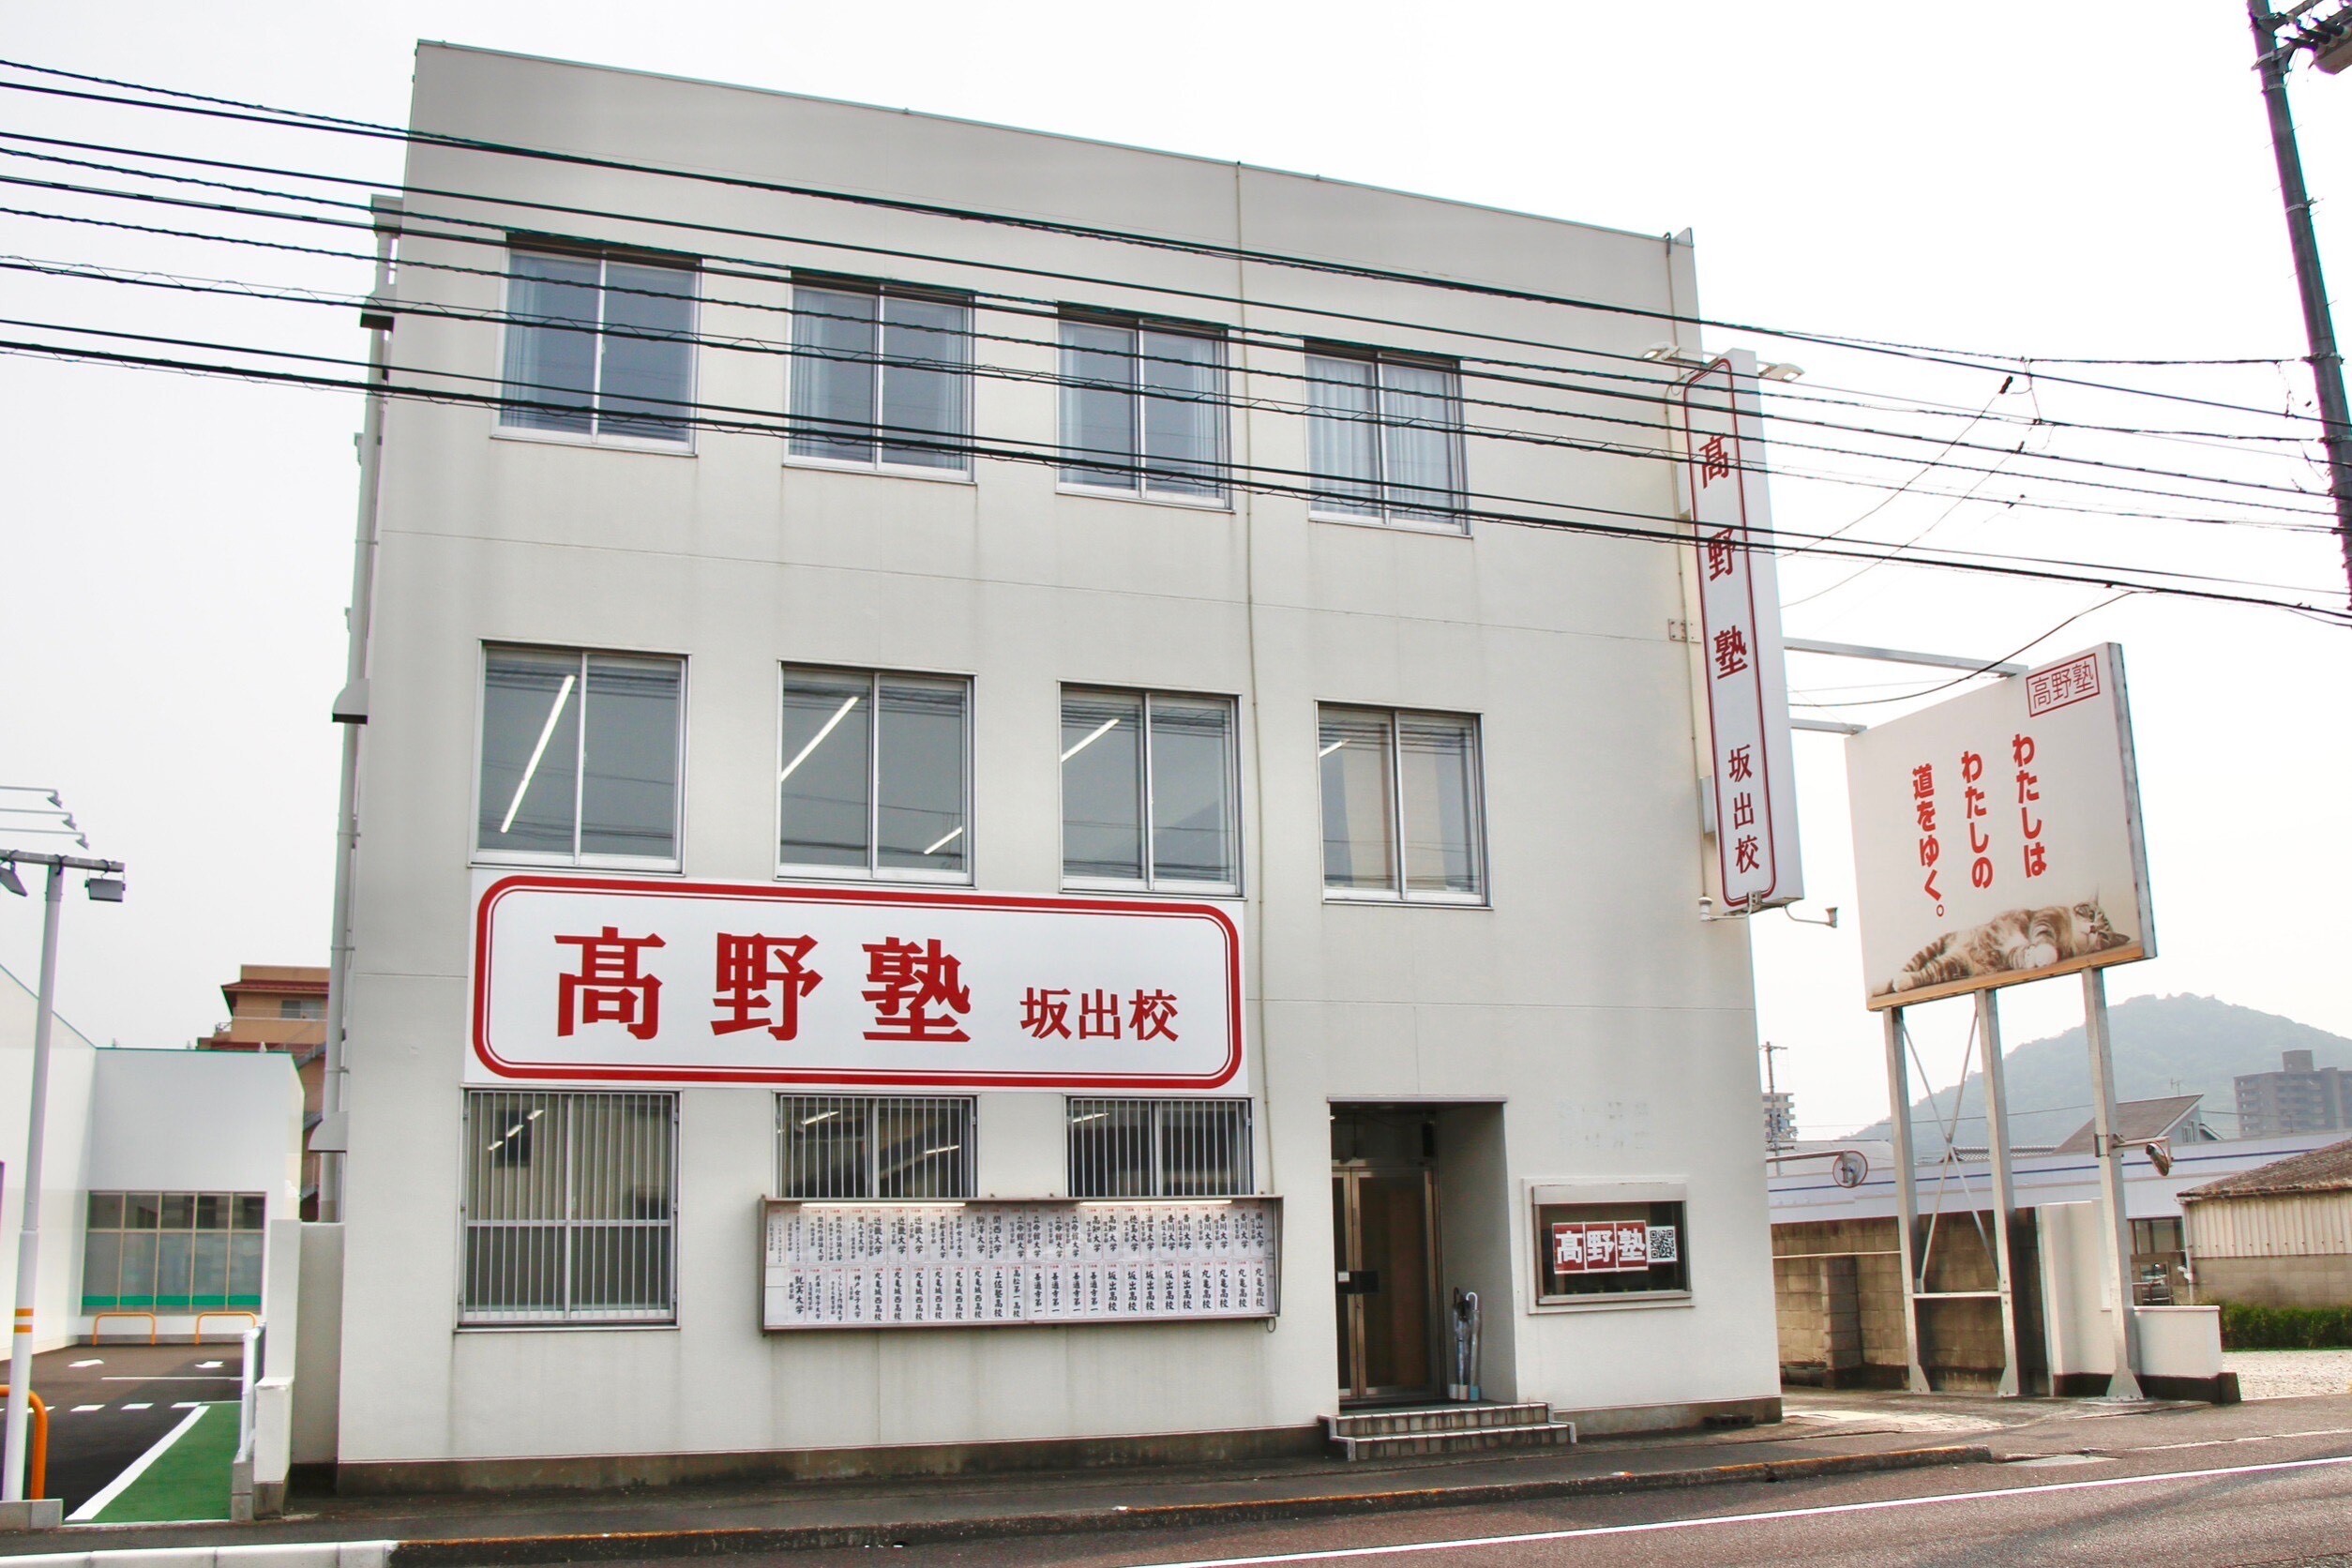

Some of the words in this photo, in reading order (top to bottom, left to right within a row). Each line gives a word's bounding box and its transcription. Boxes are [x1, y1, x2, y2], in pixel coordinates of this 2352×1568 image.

[2030, 660, 2095, 709] 高野塾
[1728, 745, 1760, 874] 坂出校
[1911, 763, 1946, 918] 道をゆく。
[1961, 750, 1994, 889] わたしの
[2012, 733, 2047, 878] わたしは
[1018, 987, 1179, 1042] 坂出校
